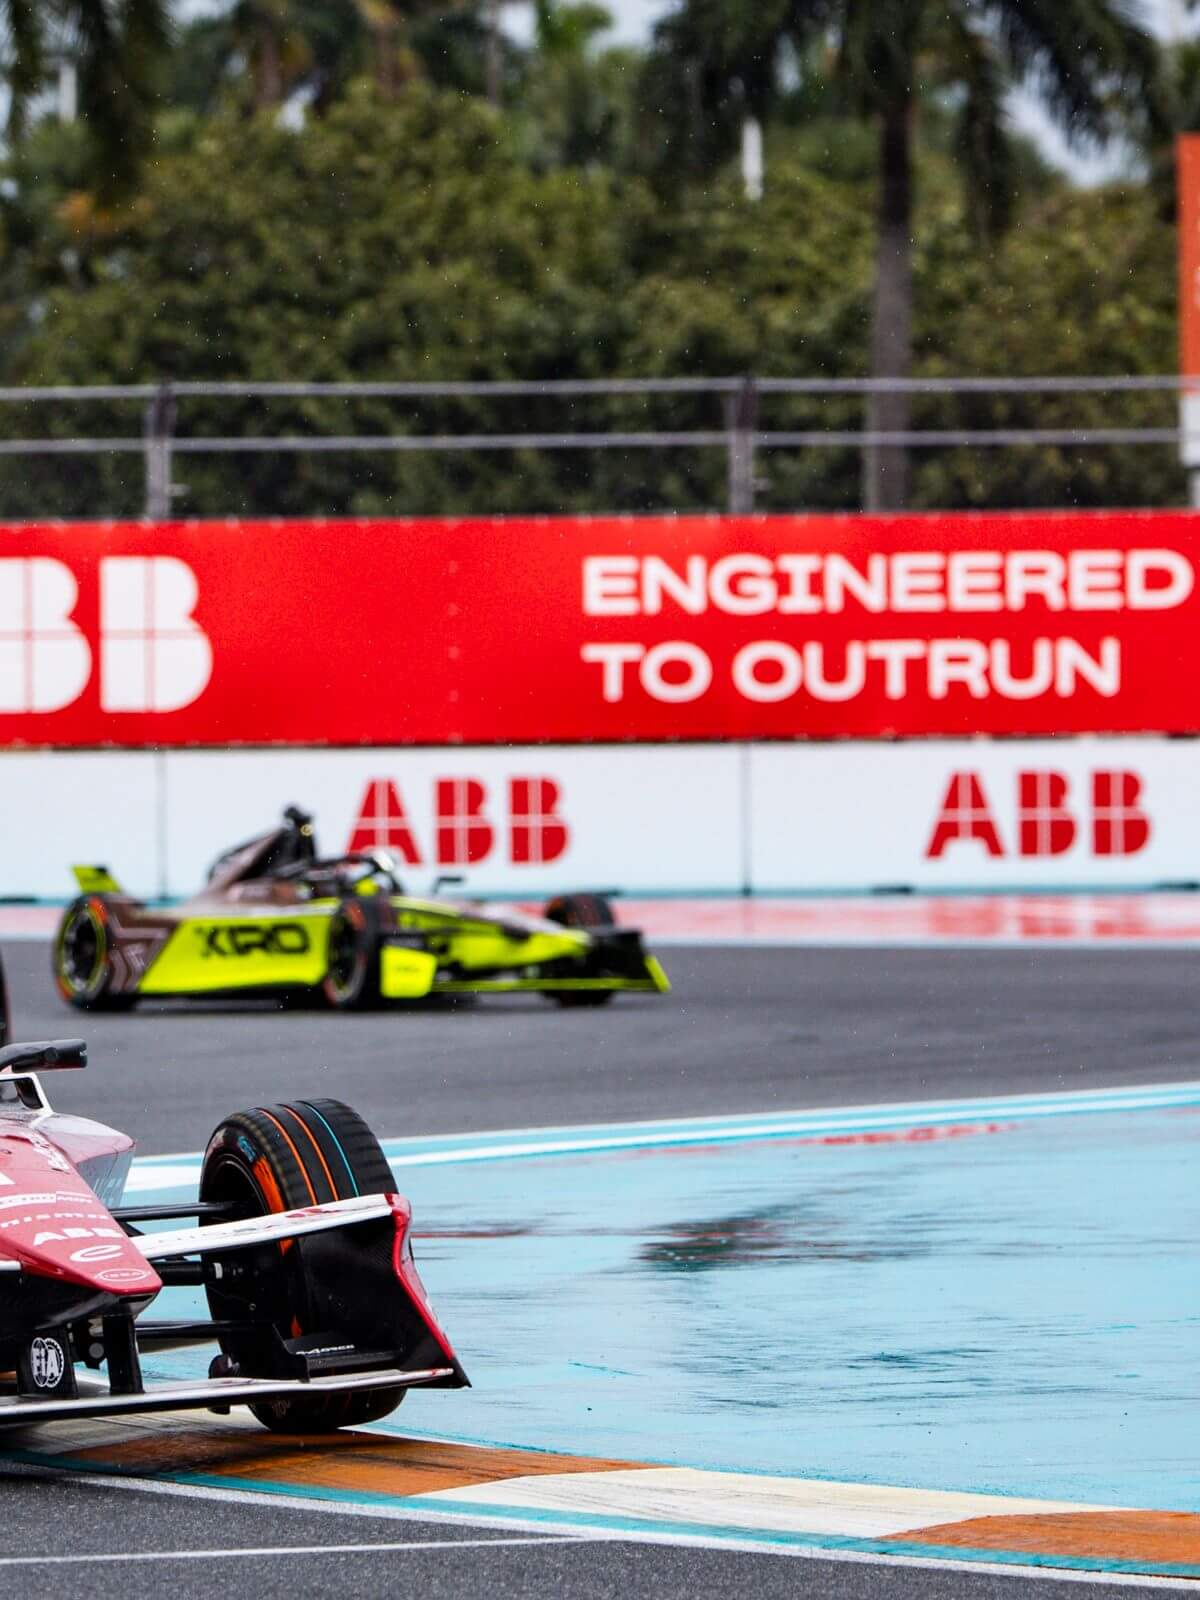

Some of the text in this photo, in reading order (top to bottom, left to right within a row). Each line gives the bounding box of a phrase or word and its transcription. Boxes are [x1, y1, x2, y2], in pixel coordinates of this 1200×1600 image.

[582, 550, 1193, 616] ENGINEERED
[582, 637, 1121, 703] TO OUTRUN
[347, 777, 569, 867] ABB
[926, 770, 1151, 859] ABB
[32, 1227, 124, 1246] ABB
[32, 1347, 60, 1377] FIA
